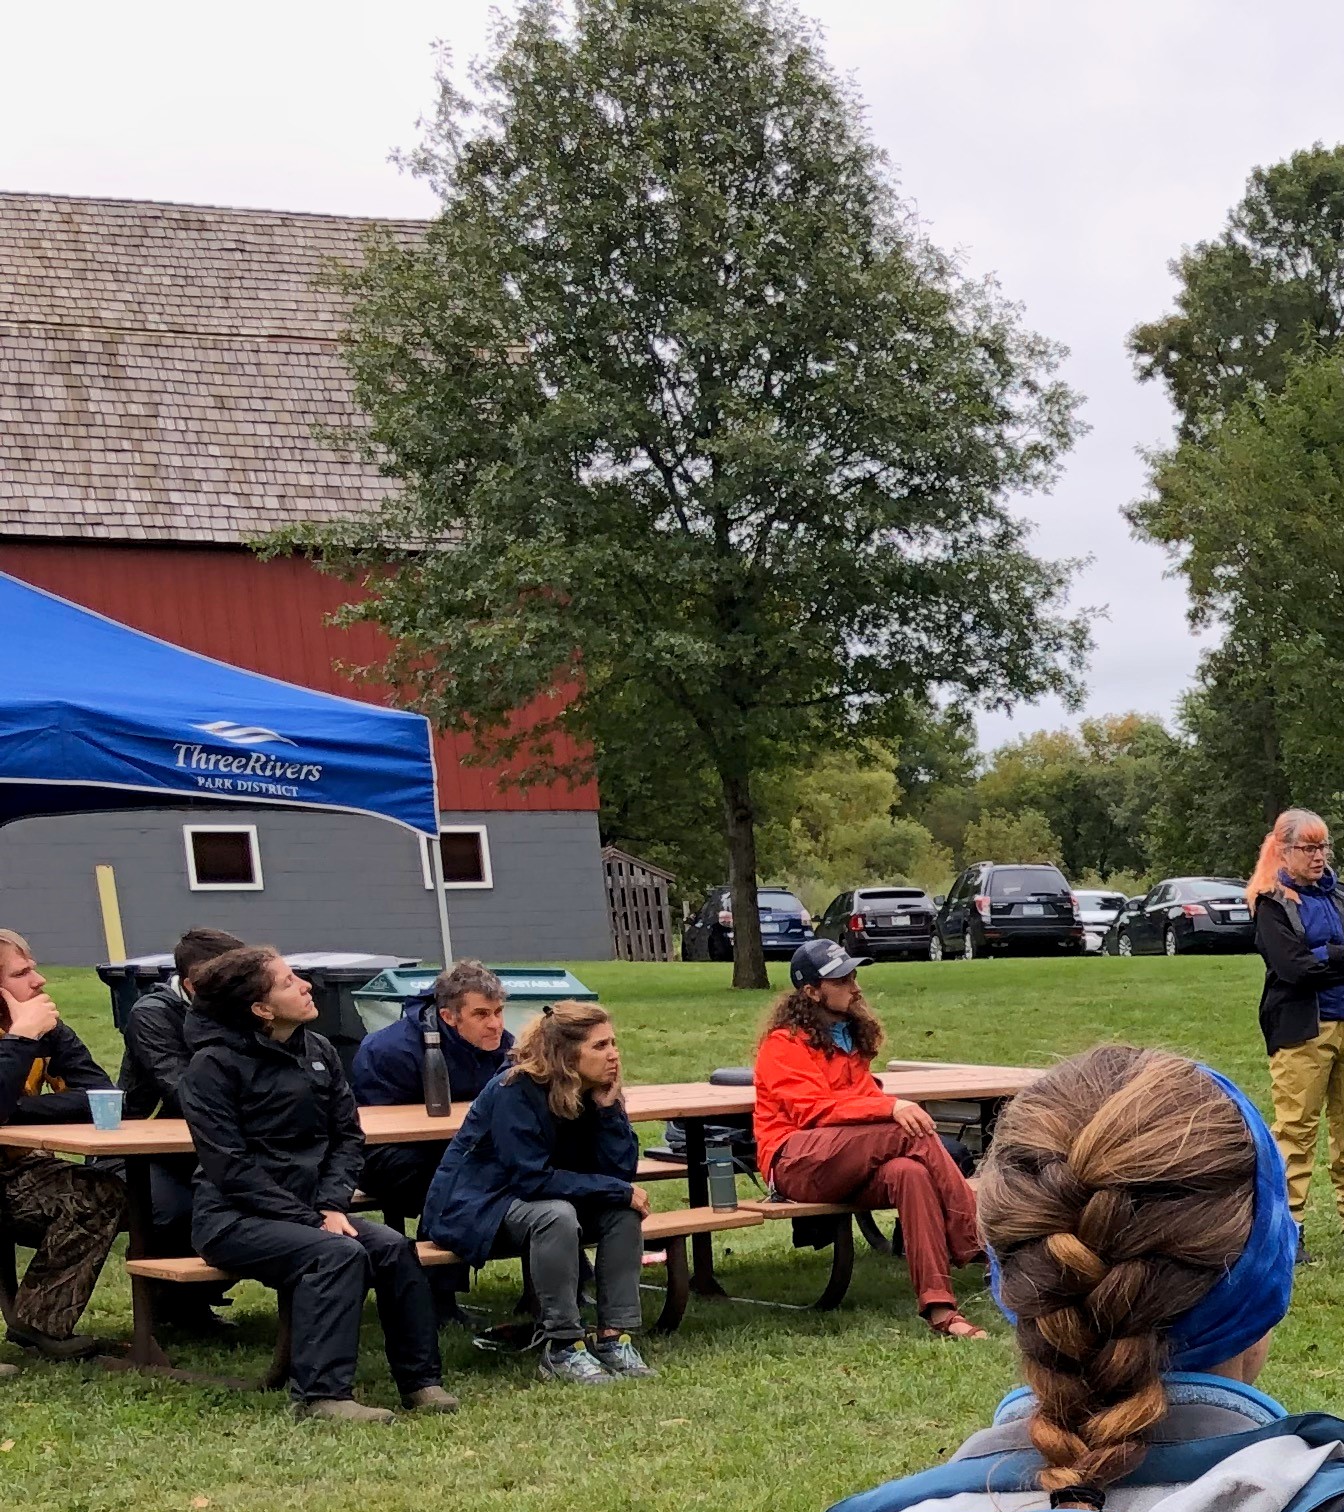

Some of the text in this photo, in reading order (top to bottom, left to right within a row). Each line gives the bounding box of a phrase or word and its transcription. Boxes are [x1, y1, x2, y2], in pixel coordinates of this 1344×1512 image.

[172, 743, 323, 782] ThreeRivers
[197, 775, 299, 797] PARK DISTRICT
